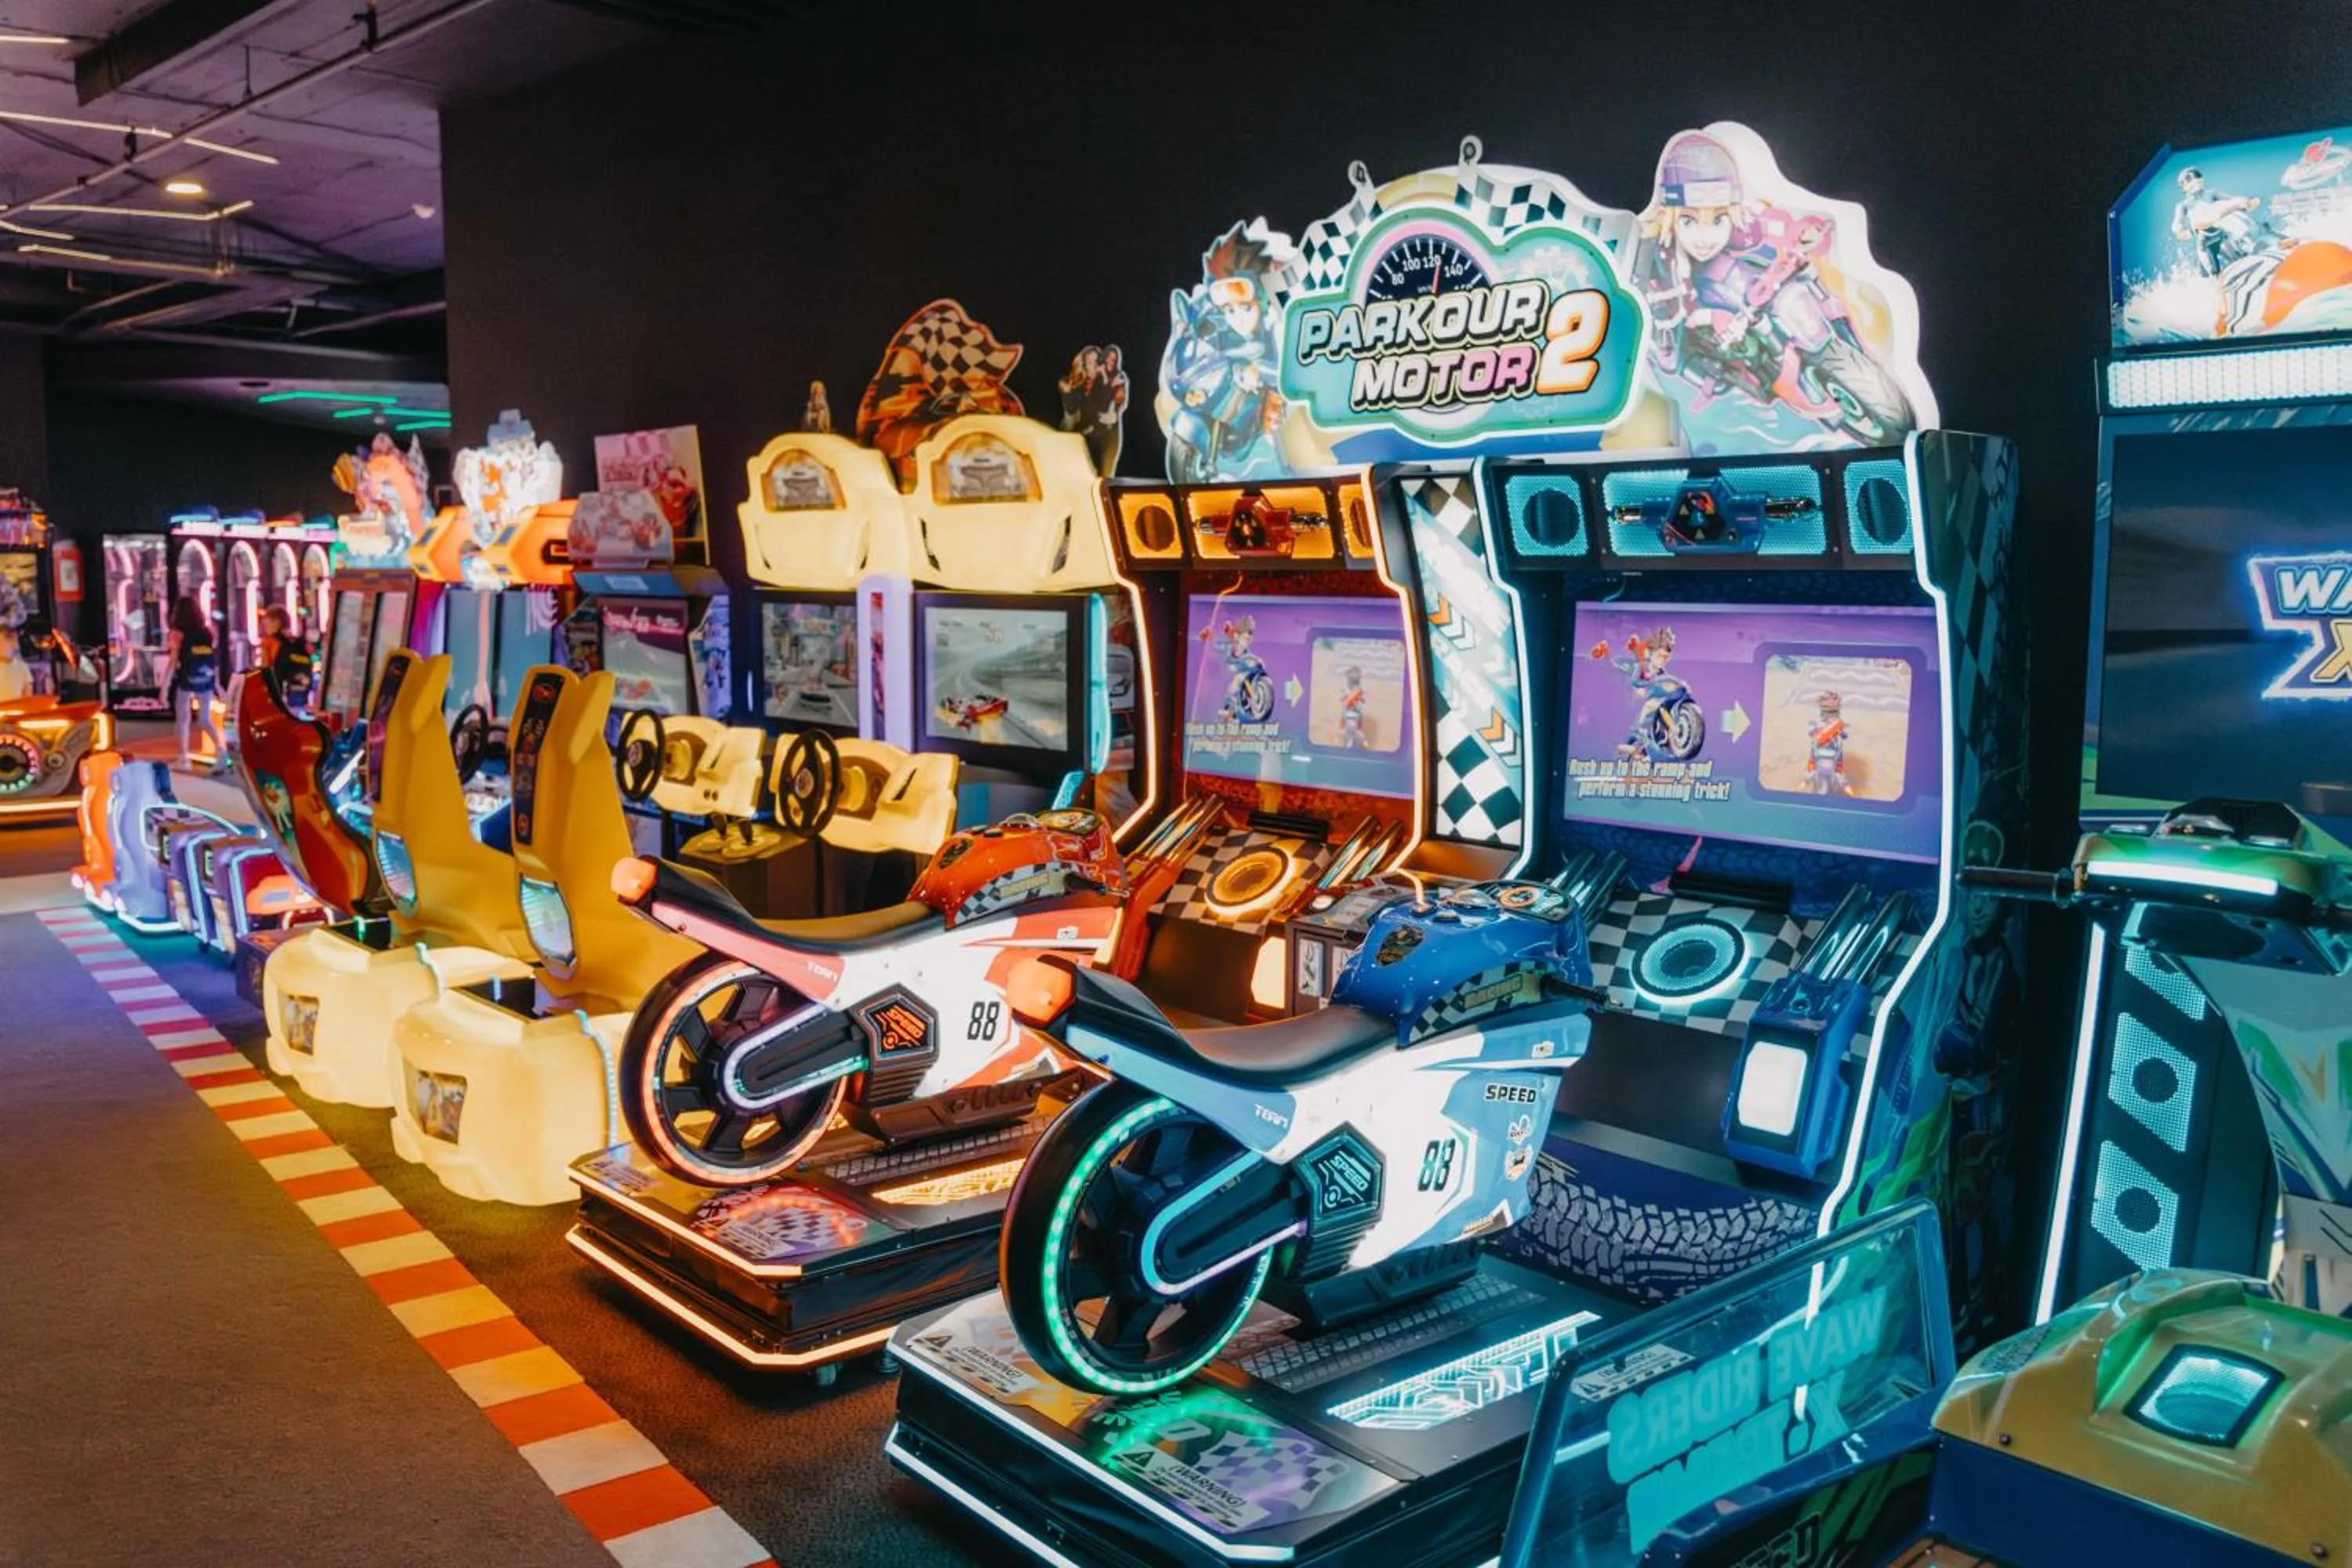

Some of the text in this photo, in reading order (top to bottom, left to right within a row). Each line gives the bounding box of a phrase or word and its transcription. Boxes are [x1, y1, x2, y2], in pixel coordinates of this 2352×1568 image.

[1392, 254, 1463, 285] 80 100 120 140
[1299, 281, 1547, 364] PARKOUR
[1534, 288, 1610, 395] 2
[1350, 343, 1541, 411] MOTOR
[1632, 757, 1650, 776] the
[1689, 760, 1713, 777] and
[1579, 781, 1626, 799] perform
[1639, 780, 1691, 802] stunning
[1694, 781, 1731, 800] trick!
[967, 1001, 1000, 1040] 88
[1485, 1083, 1537, 1104] SPEED
[1330, 1154, 1369, 1192] SPEED
[1417, 1138, 1456, 1192] 88
